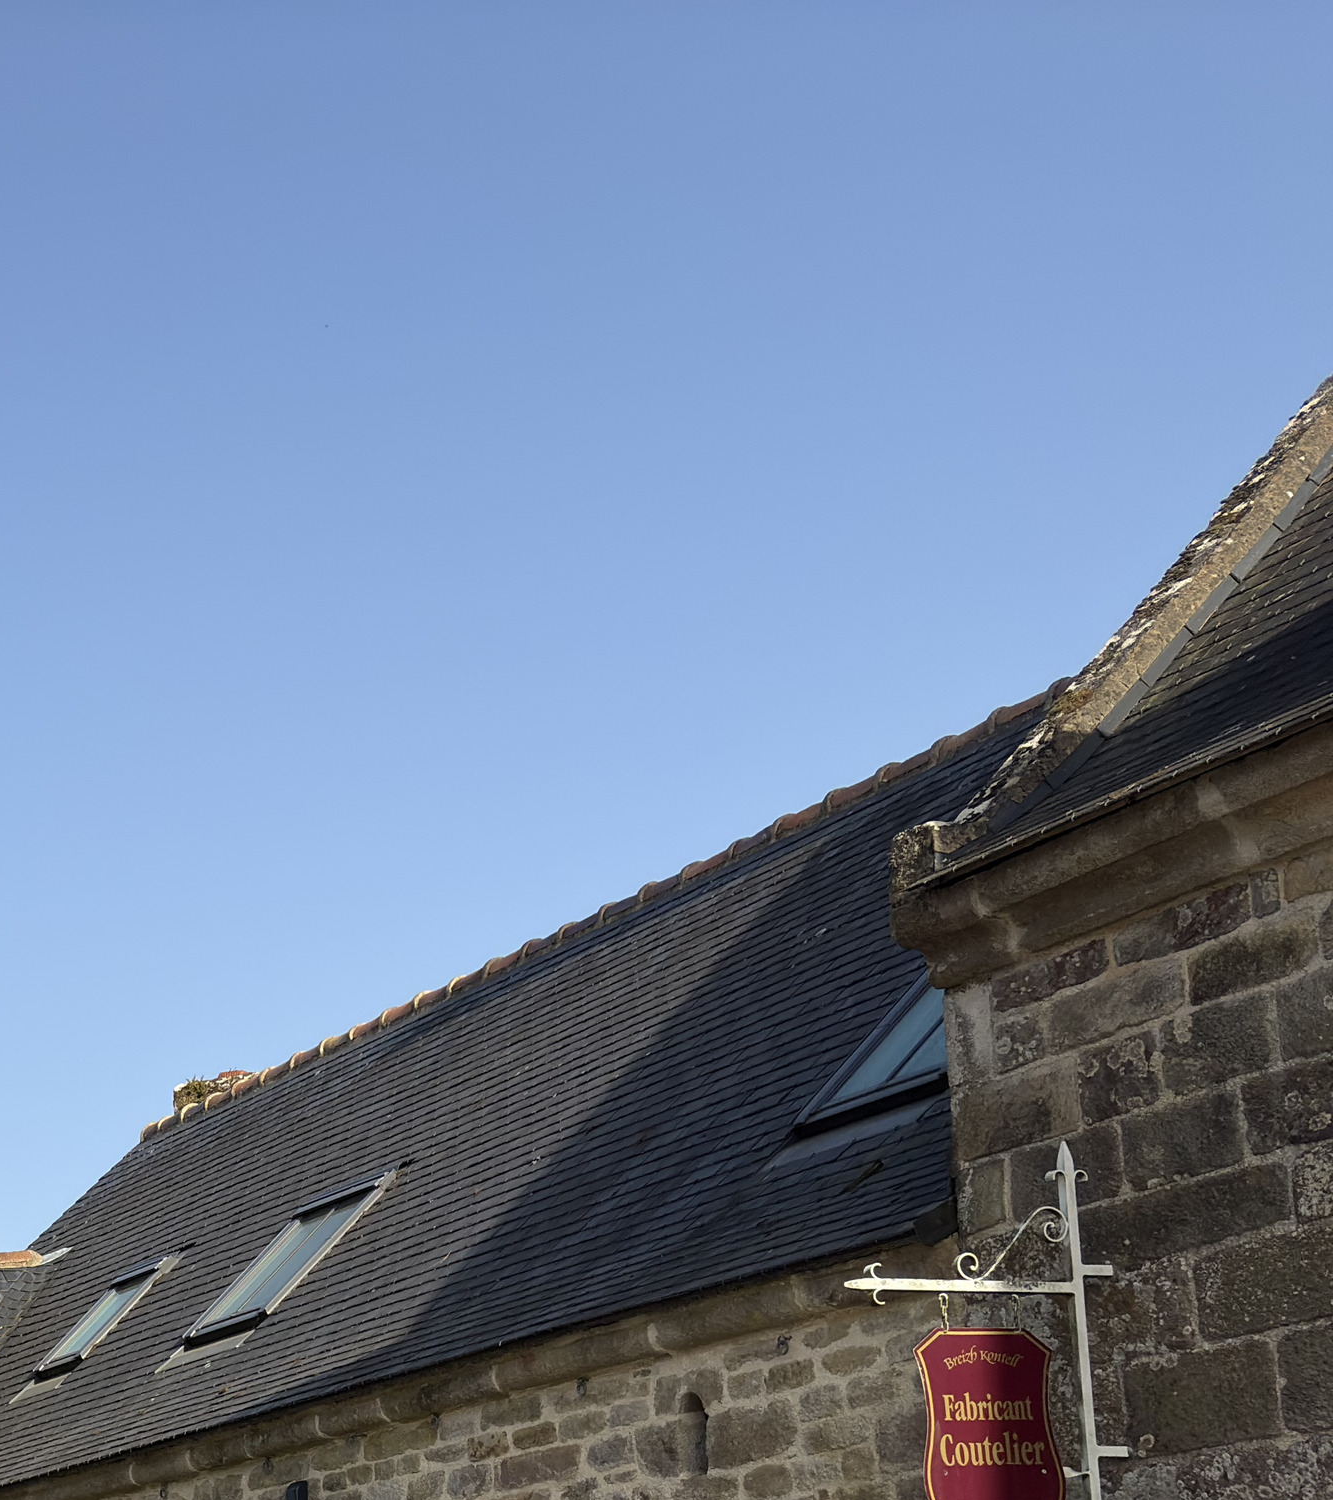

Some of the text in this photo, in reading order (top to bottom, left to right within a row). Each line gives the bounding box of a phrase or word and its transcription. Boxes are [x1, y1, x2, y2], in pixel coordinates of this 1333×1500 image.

[943, 1345, 978, 1370] Breizh
[942, 1392, 1034, 1422] Fabricant
[939, 1431, 1046, 1467] Coutelier
